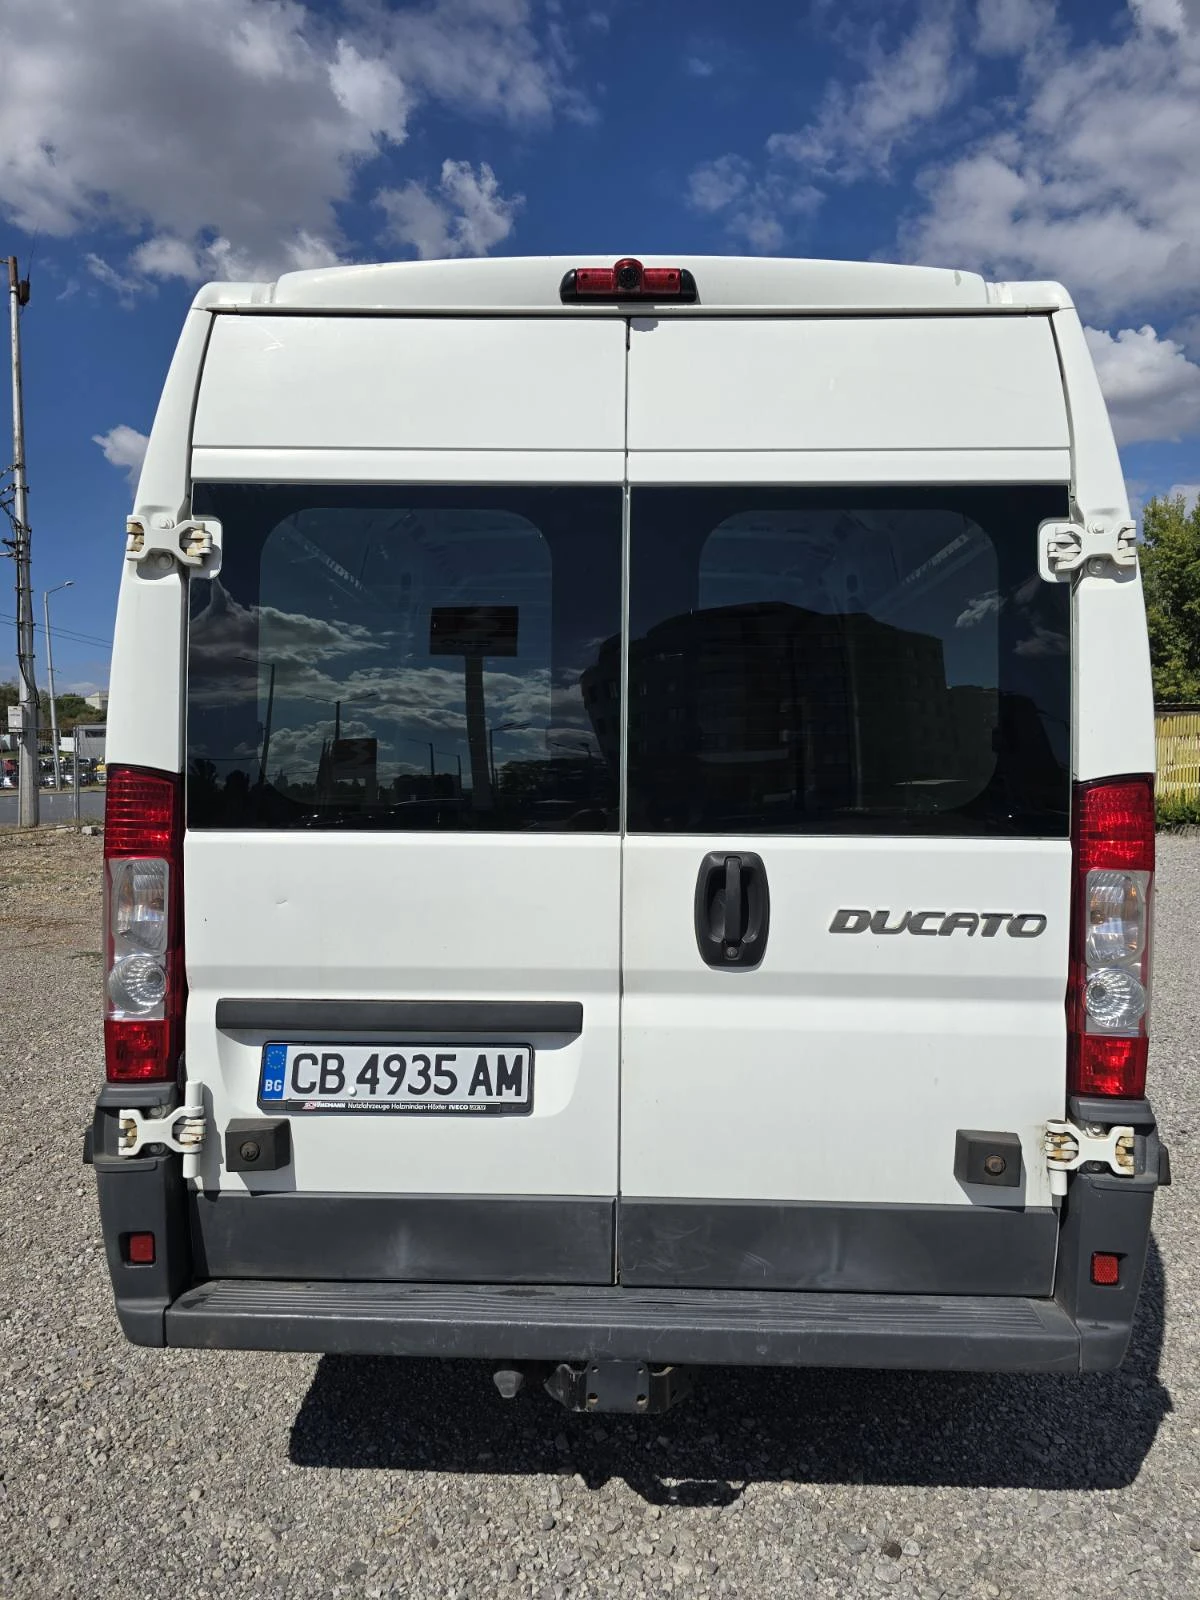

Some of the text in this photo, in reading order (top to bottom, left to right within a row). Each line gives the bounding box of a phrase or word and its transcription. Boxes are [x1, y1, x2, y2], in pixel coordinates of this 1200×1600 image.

[829, 909, 1048, 938] DUCATO
[264, 1079, 283, 1092] BG
[291, 1053, 524, 1097] CB 4935 AM
